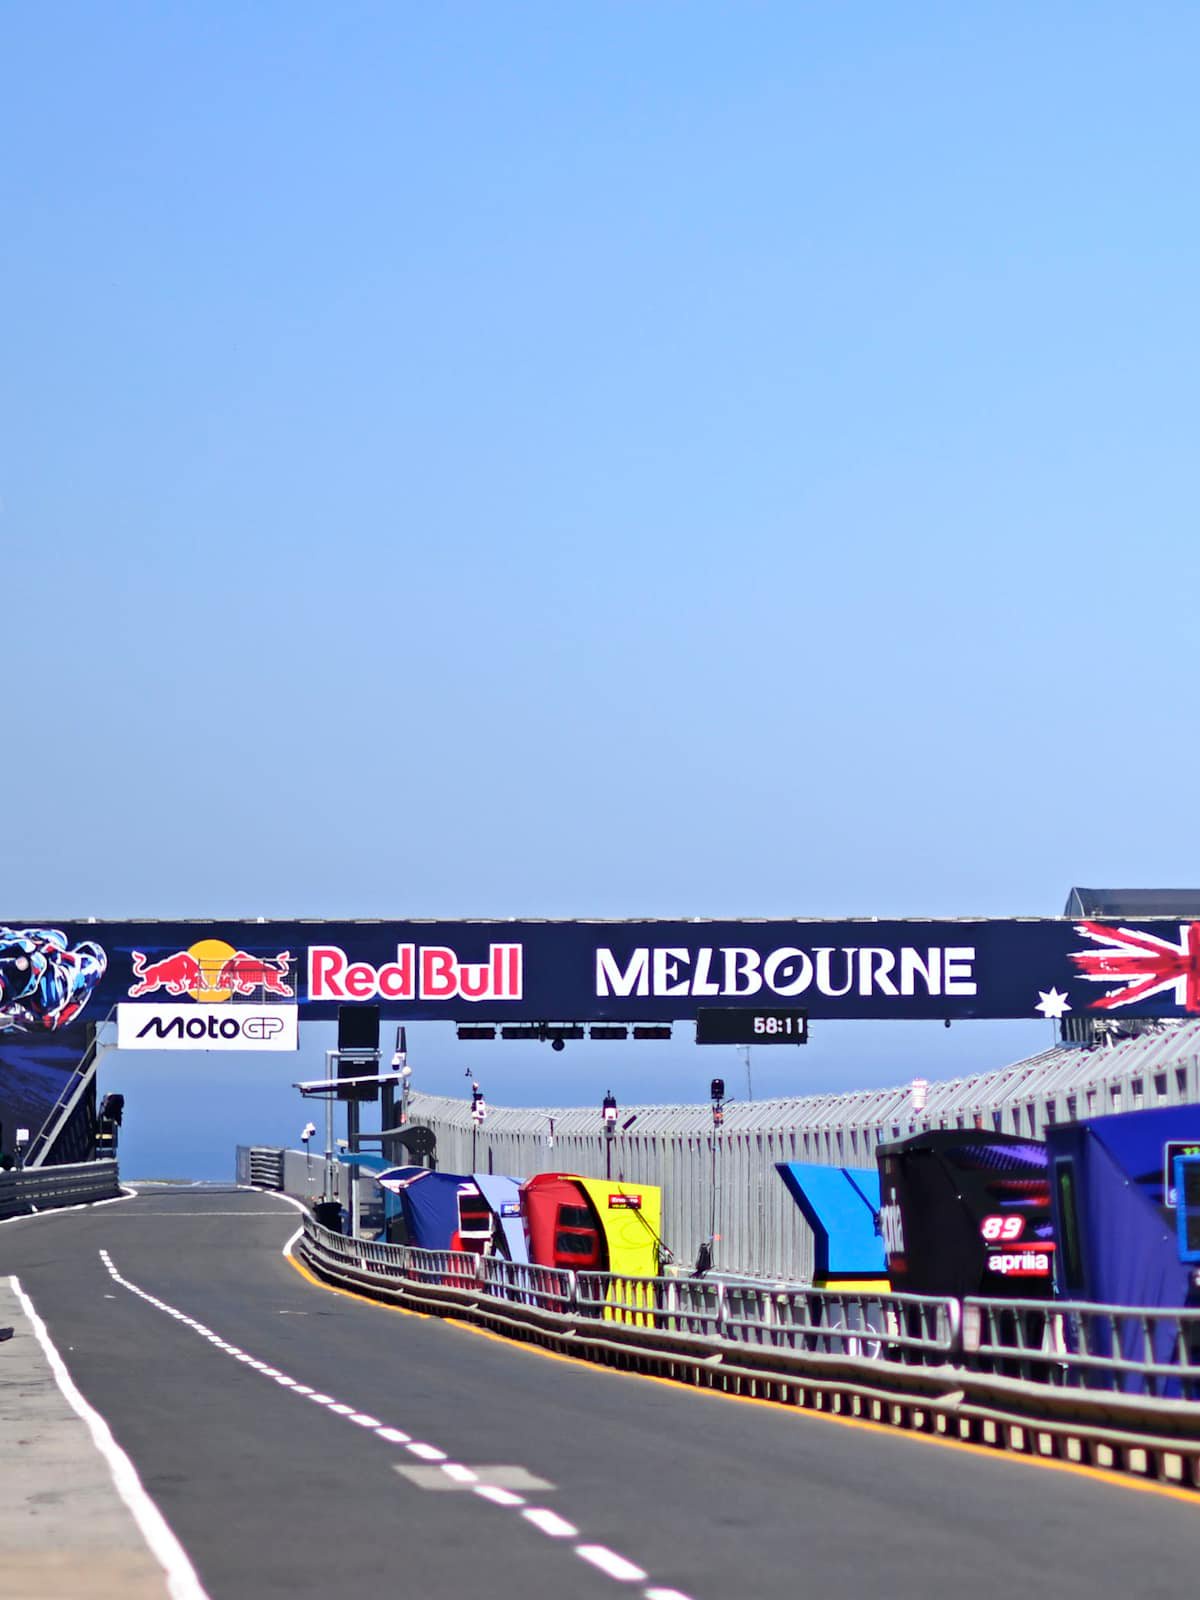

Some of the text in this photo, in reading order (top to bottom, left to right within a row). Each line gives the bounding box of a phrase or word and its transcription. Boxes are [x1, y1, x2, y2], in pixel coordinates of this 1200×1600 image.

[308, 944, 522, 1001] Red Bull
[596, 947, 977, 996] MELBOURNE
[753, 1017, 804, 1034] 58:11
[982, 1217, 1022, 1239] 89
[988, 1251, 1049, 1274] aprilia
